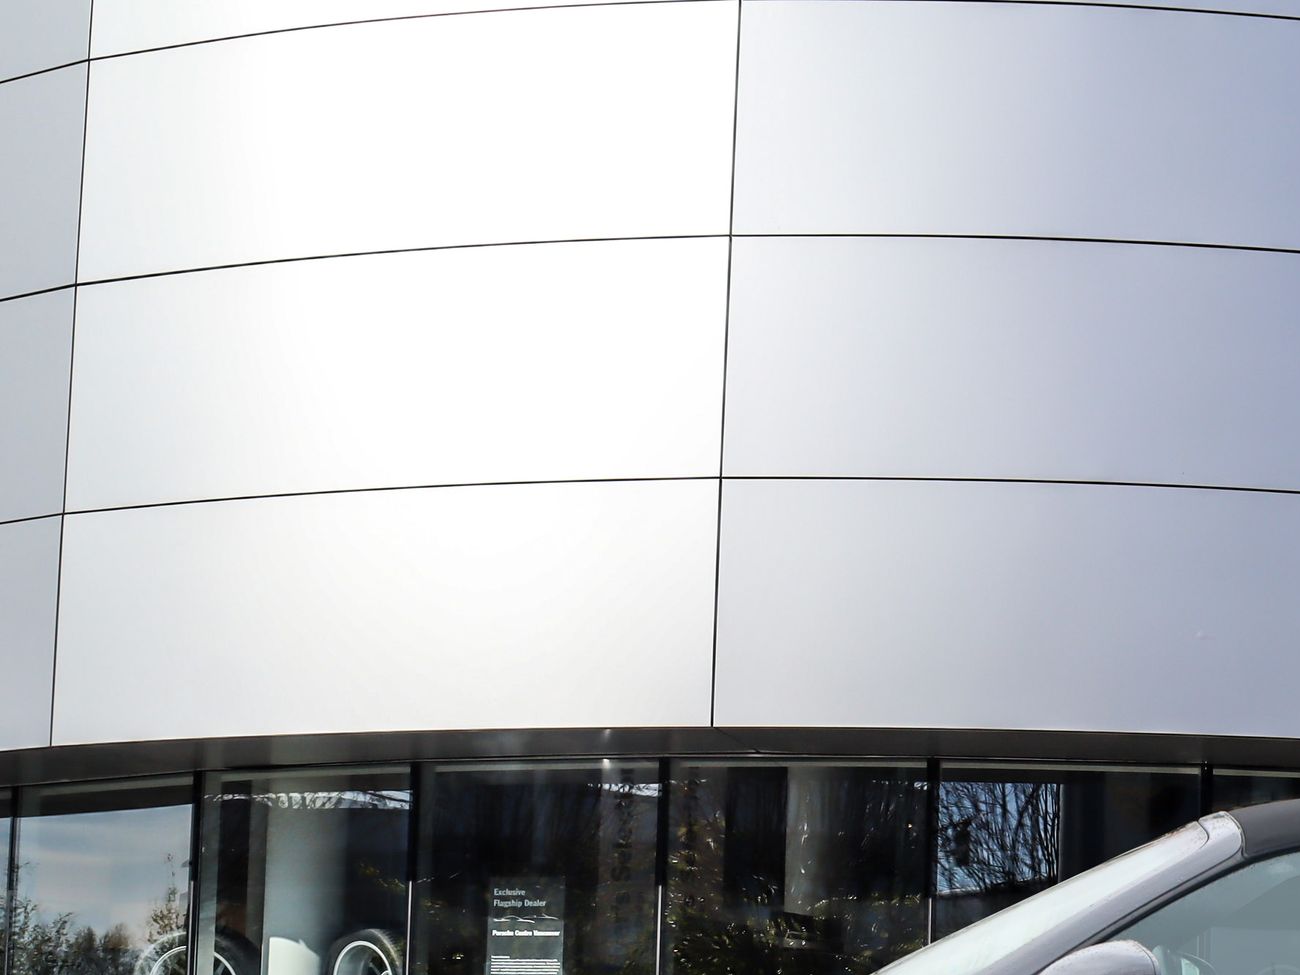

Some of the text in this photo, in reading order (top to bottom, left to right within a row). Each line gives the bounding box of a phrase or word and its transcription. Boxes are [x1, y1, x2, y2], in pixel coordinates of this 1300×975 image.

[493, 887, 526, 896] Exclusive
[493, 899, 547, 908] Flagship Dealer
